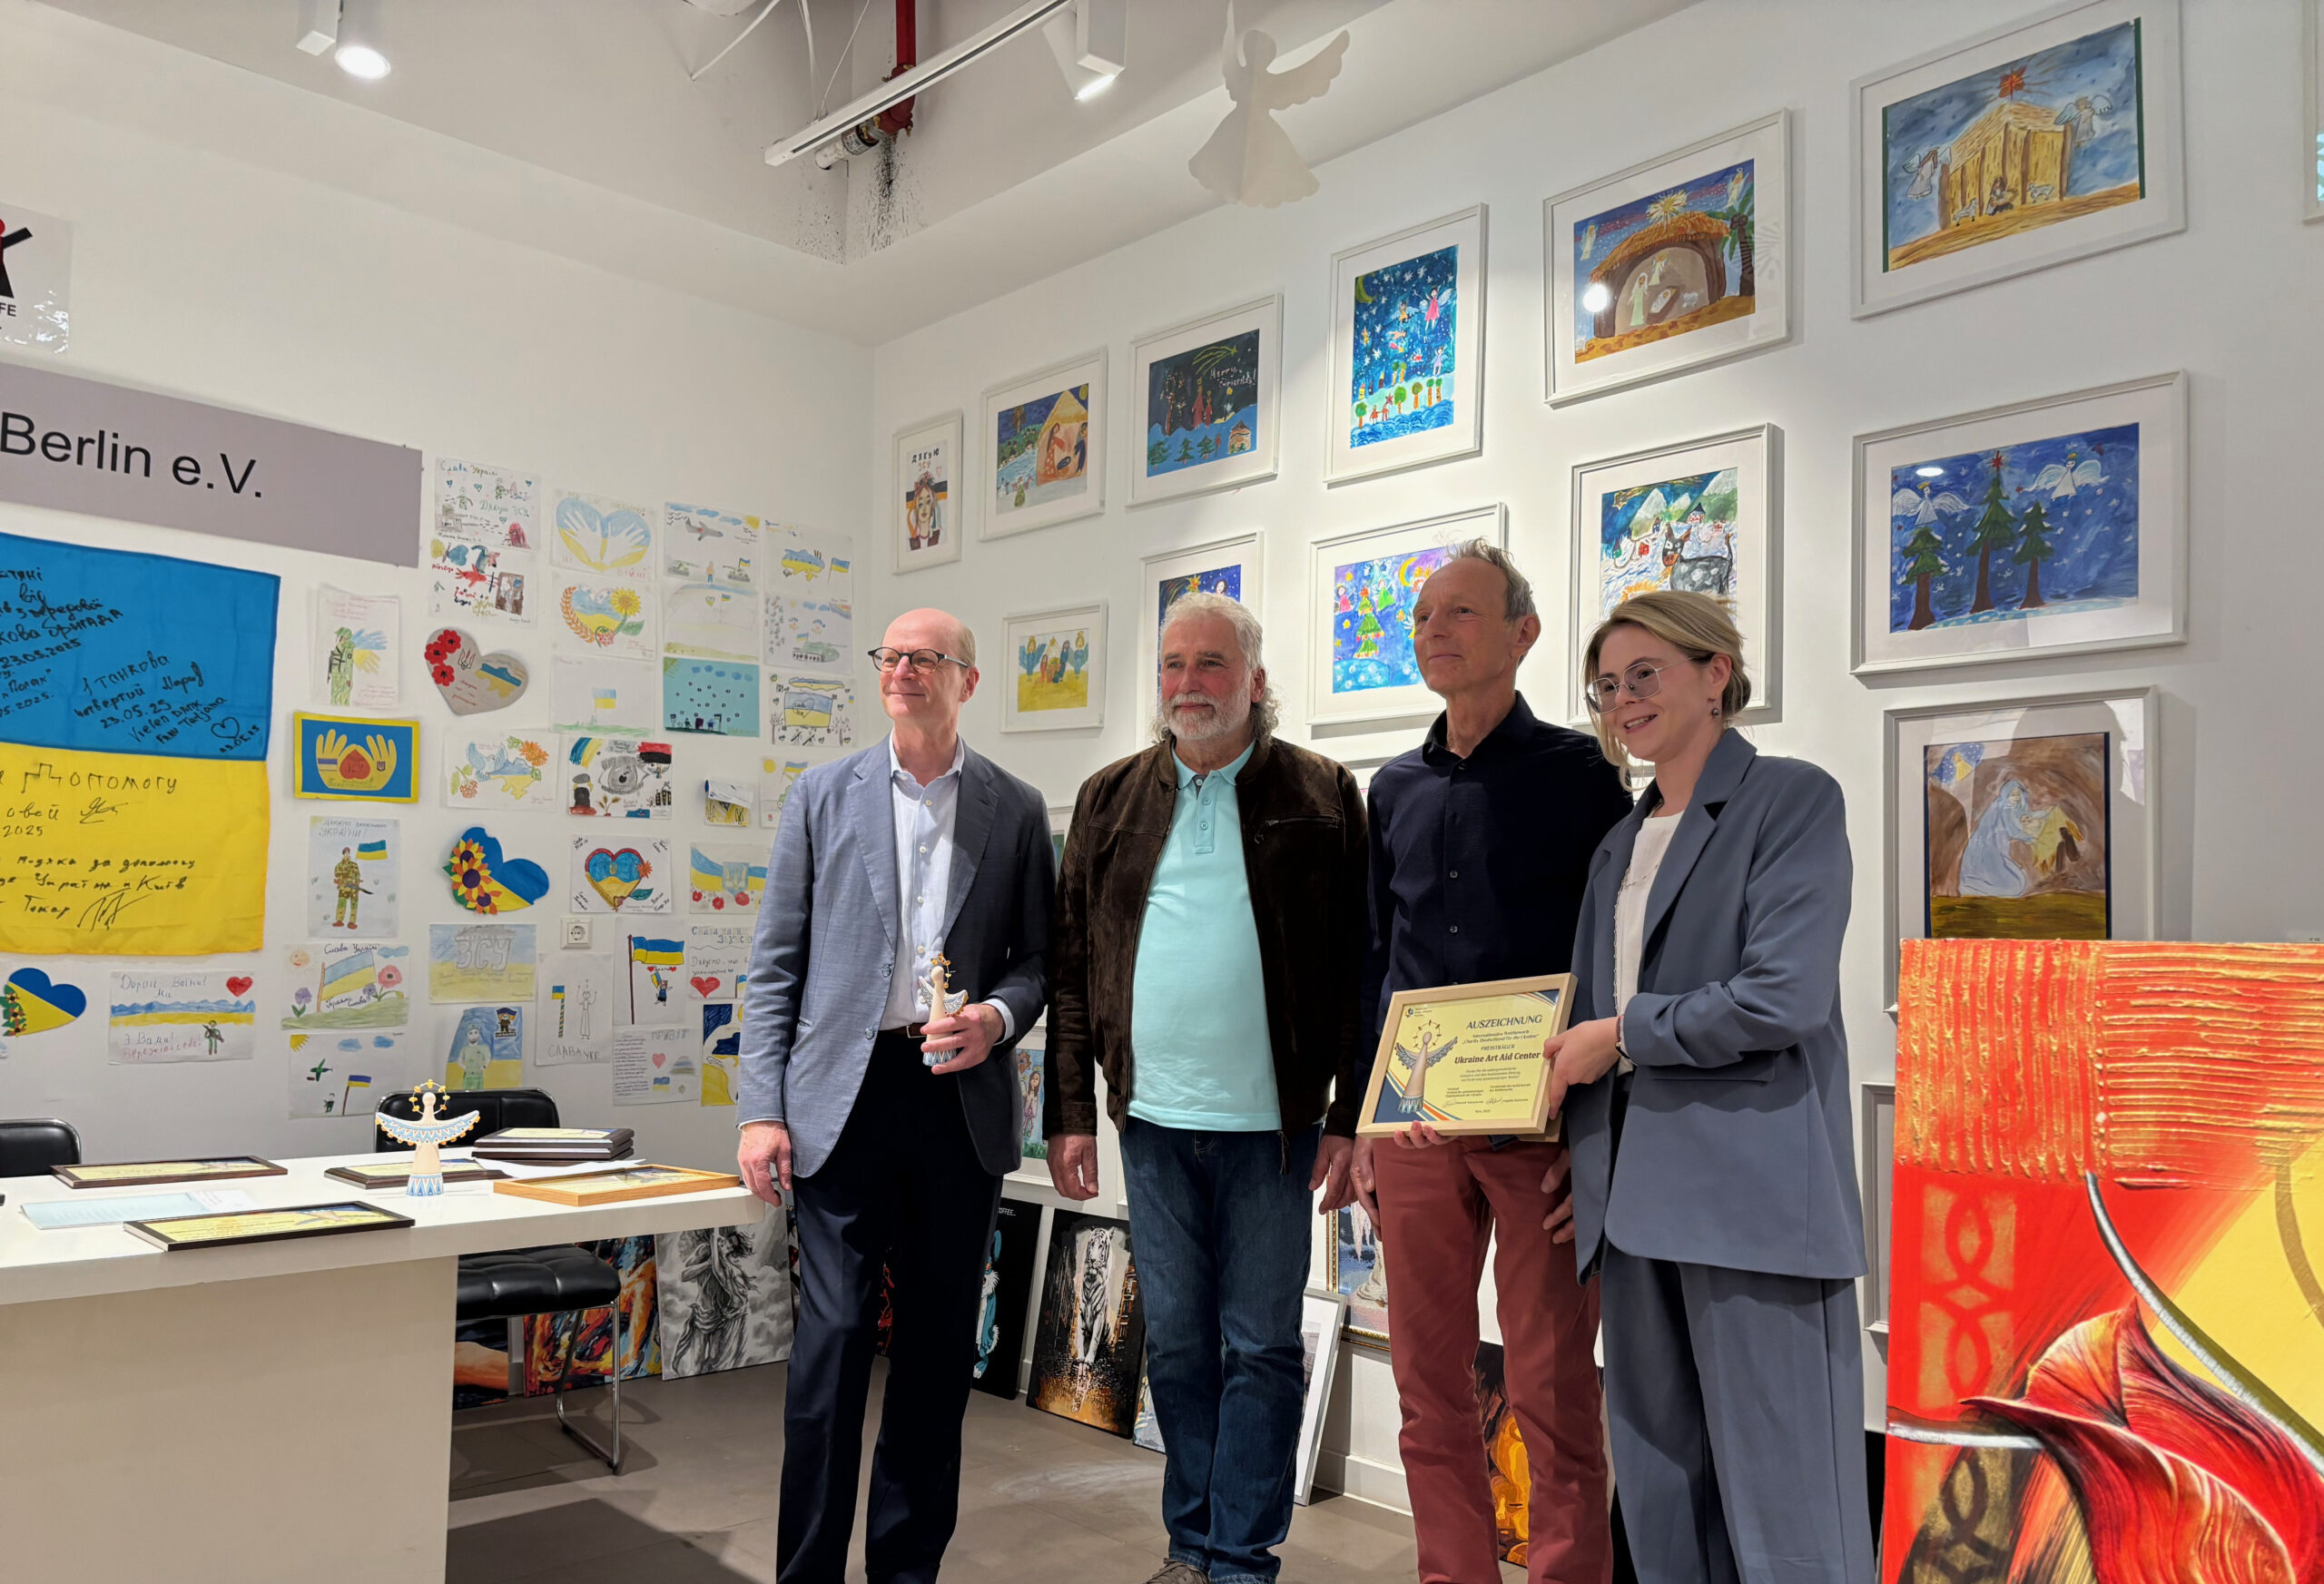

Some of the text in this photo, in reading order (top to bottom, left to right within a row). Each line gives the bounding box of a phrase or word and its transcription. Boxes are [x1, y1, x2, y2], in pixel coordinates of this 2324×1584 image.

[1, 411, 262, 498] Berlin e.V.
[455, 937, 512, 972] ЗСУ
[1466, 1014, 1543, 1029] AUSZEICHNUNG
[1454, 1051, 1541, 1065] Ukraine Art Aid Center
